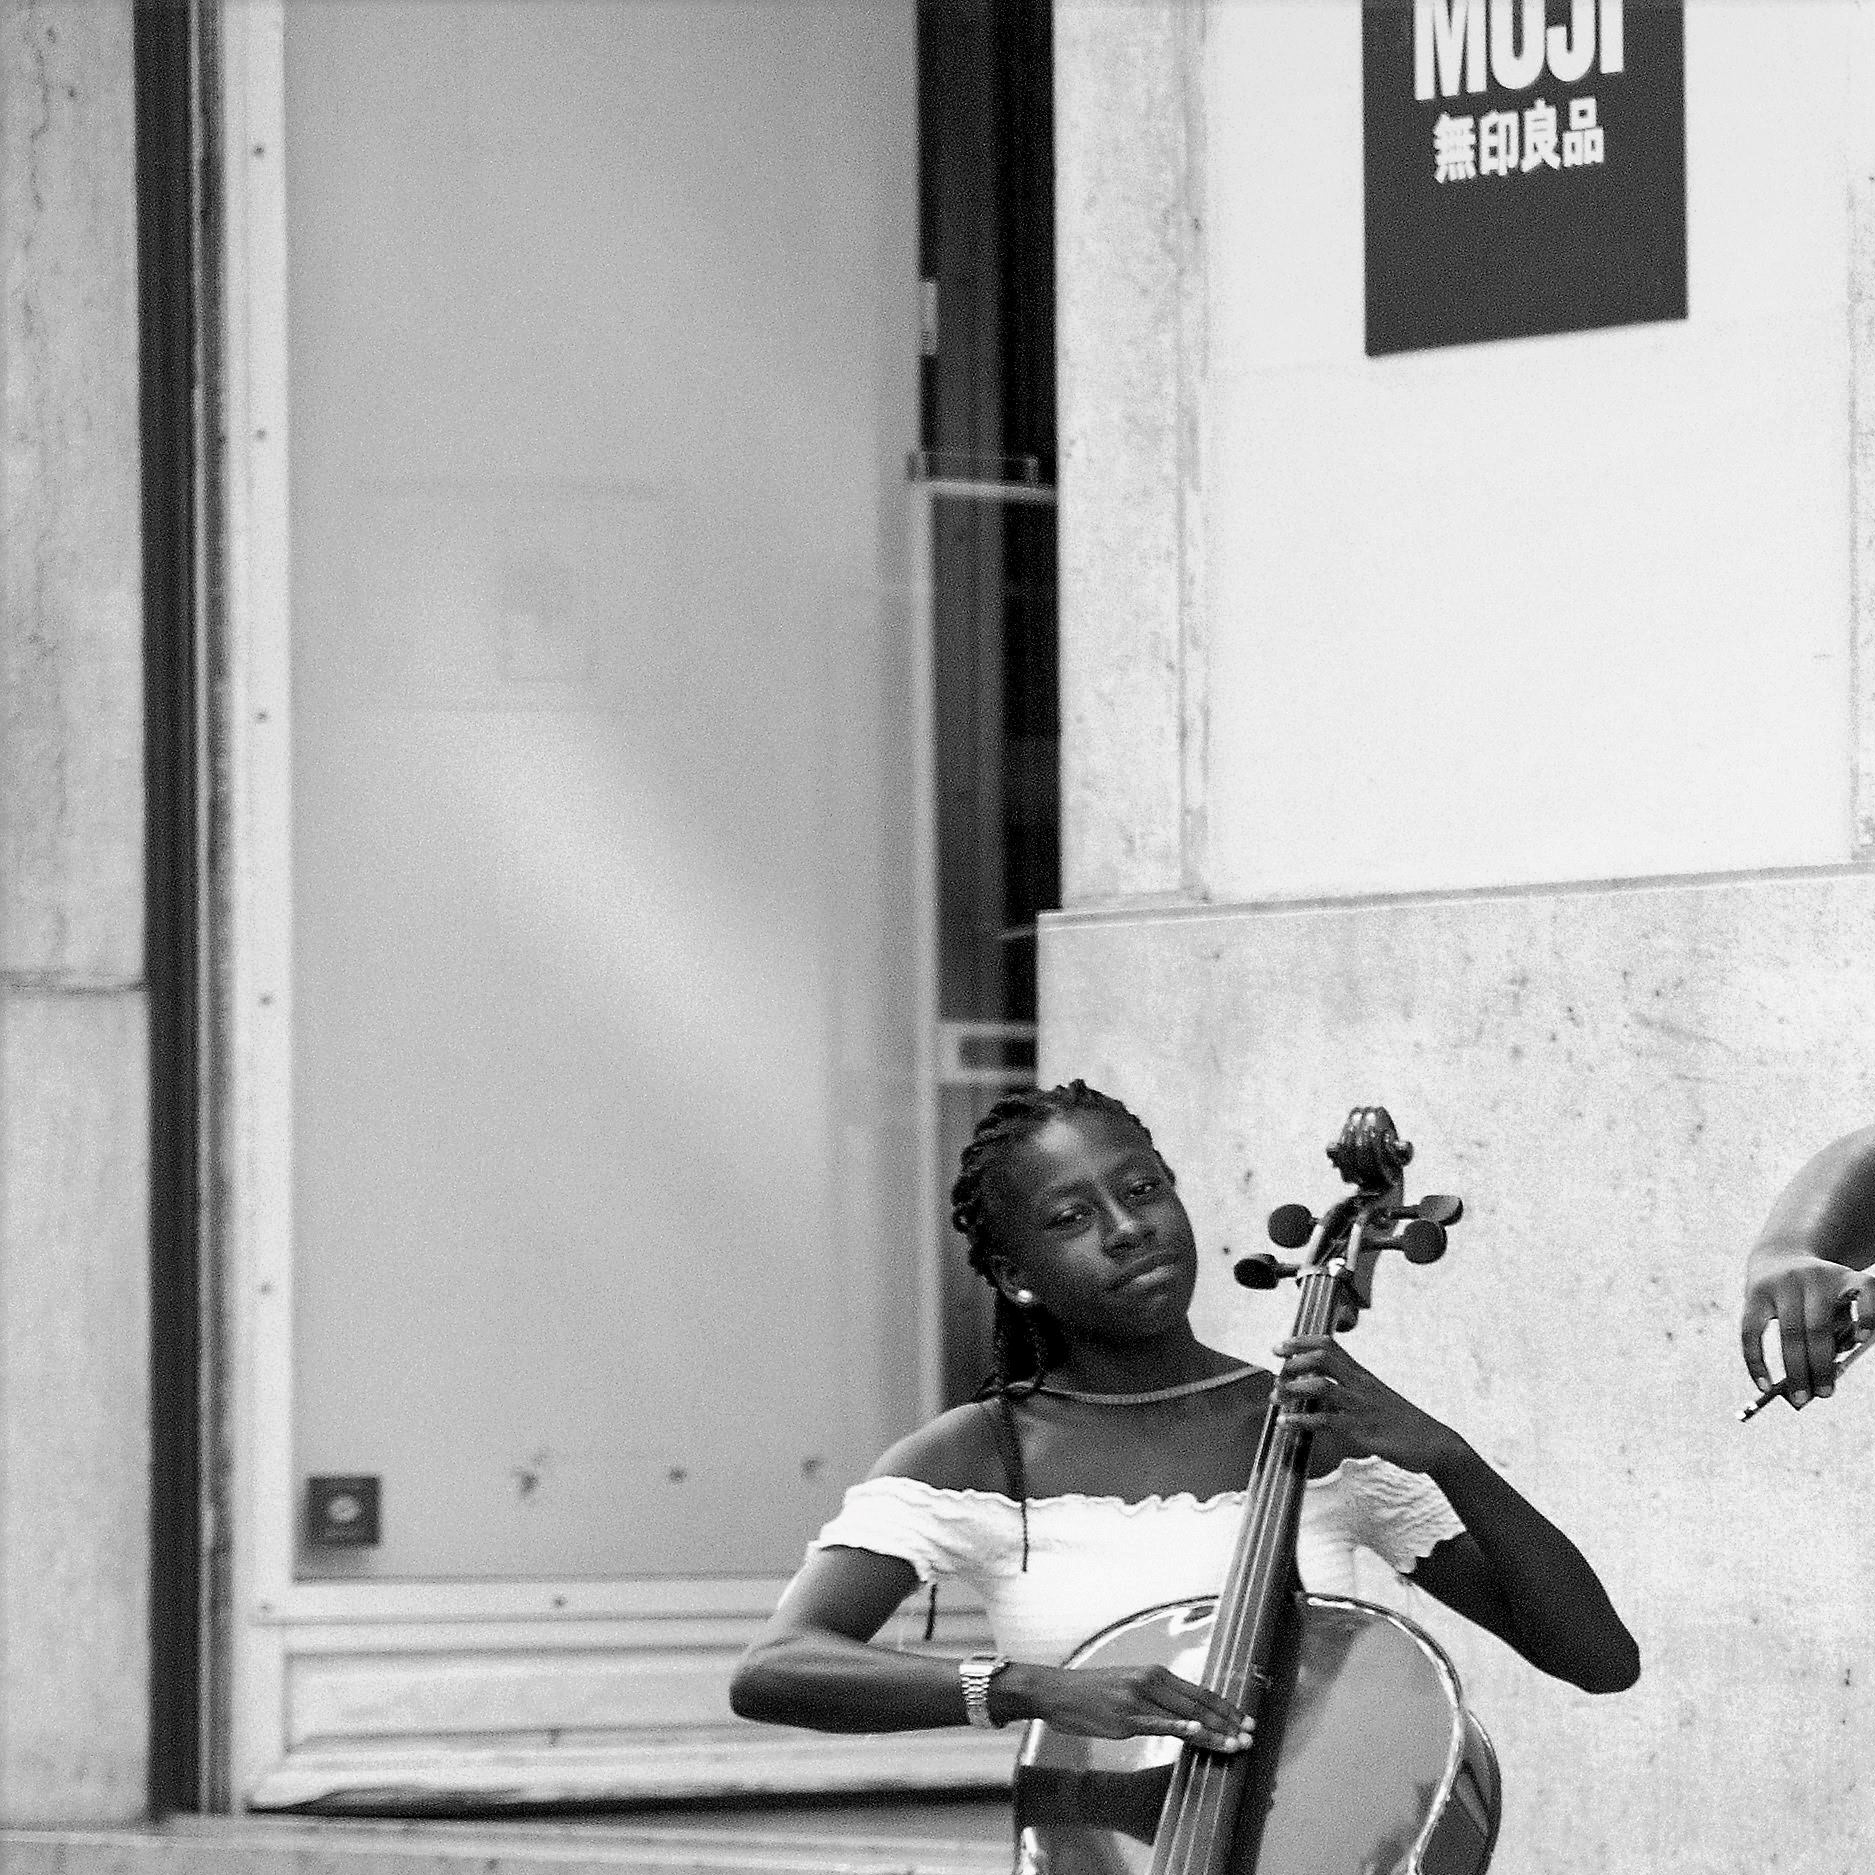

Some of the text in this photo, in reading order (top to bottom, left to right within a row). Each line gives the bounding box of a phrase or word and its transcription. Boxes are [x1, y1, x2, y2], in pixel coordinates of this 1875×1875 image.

[1414, 0, 1624, 101] MUJI
[1433, 97, 1605, 184] 無印良品
